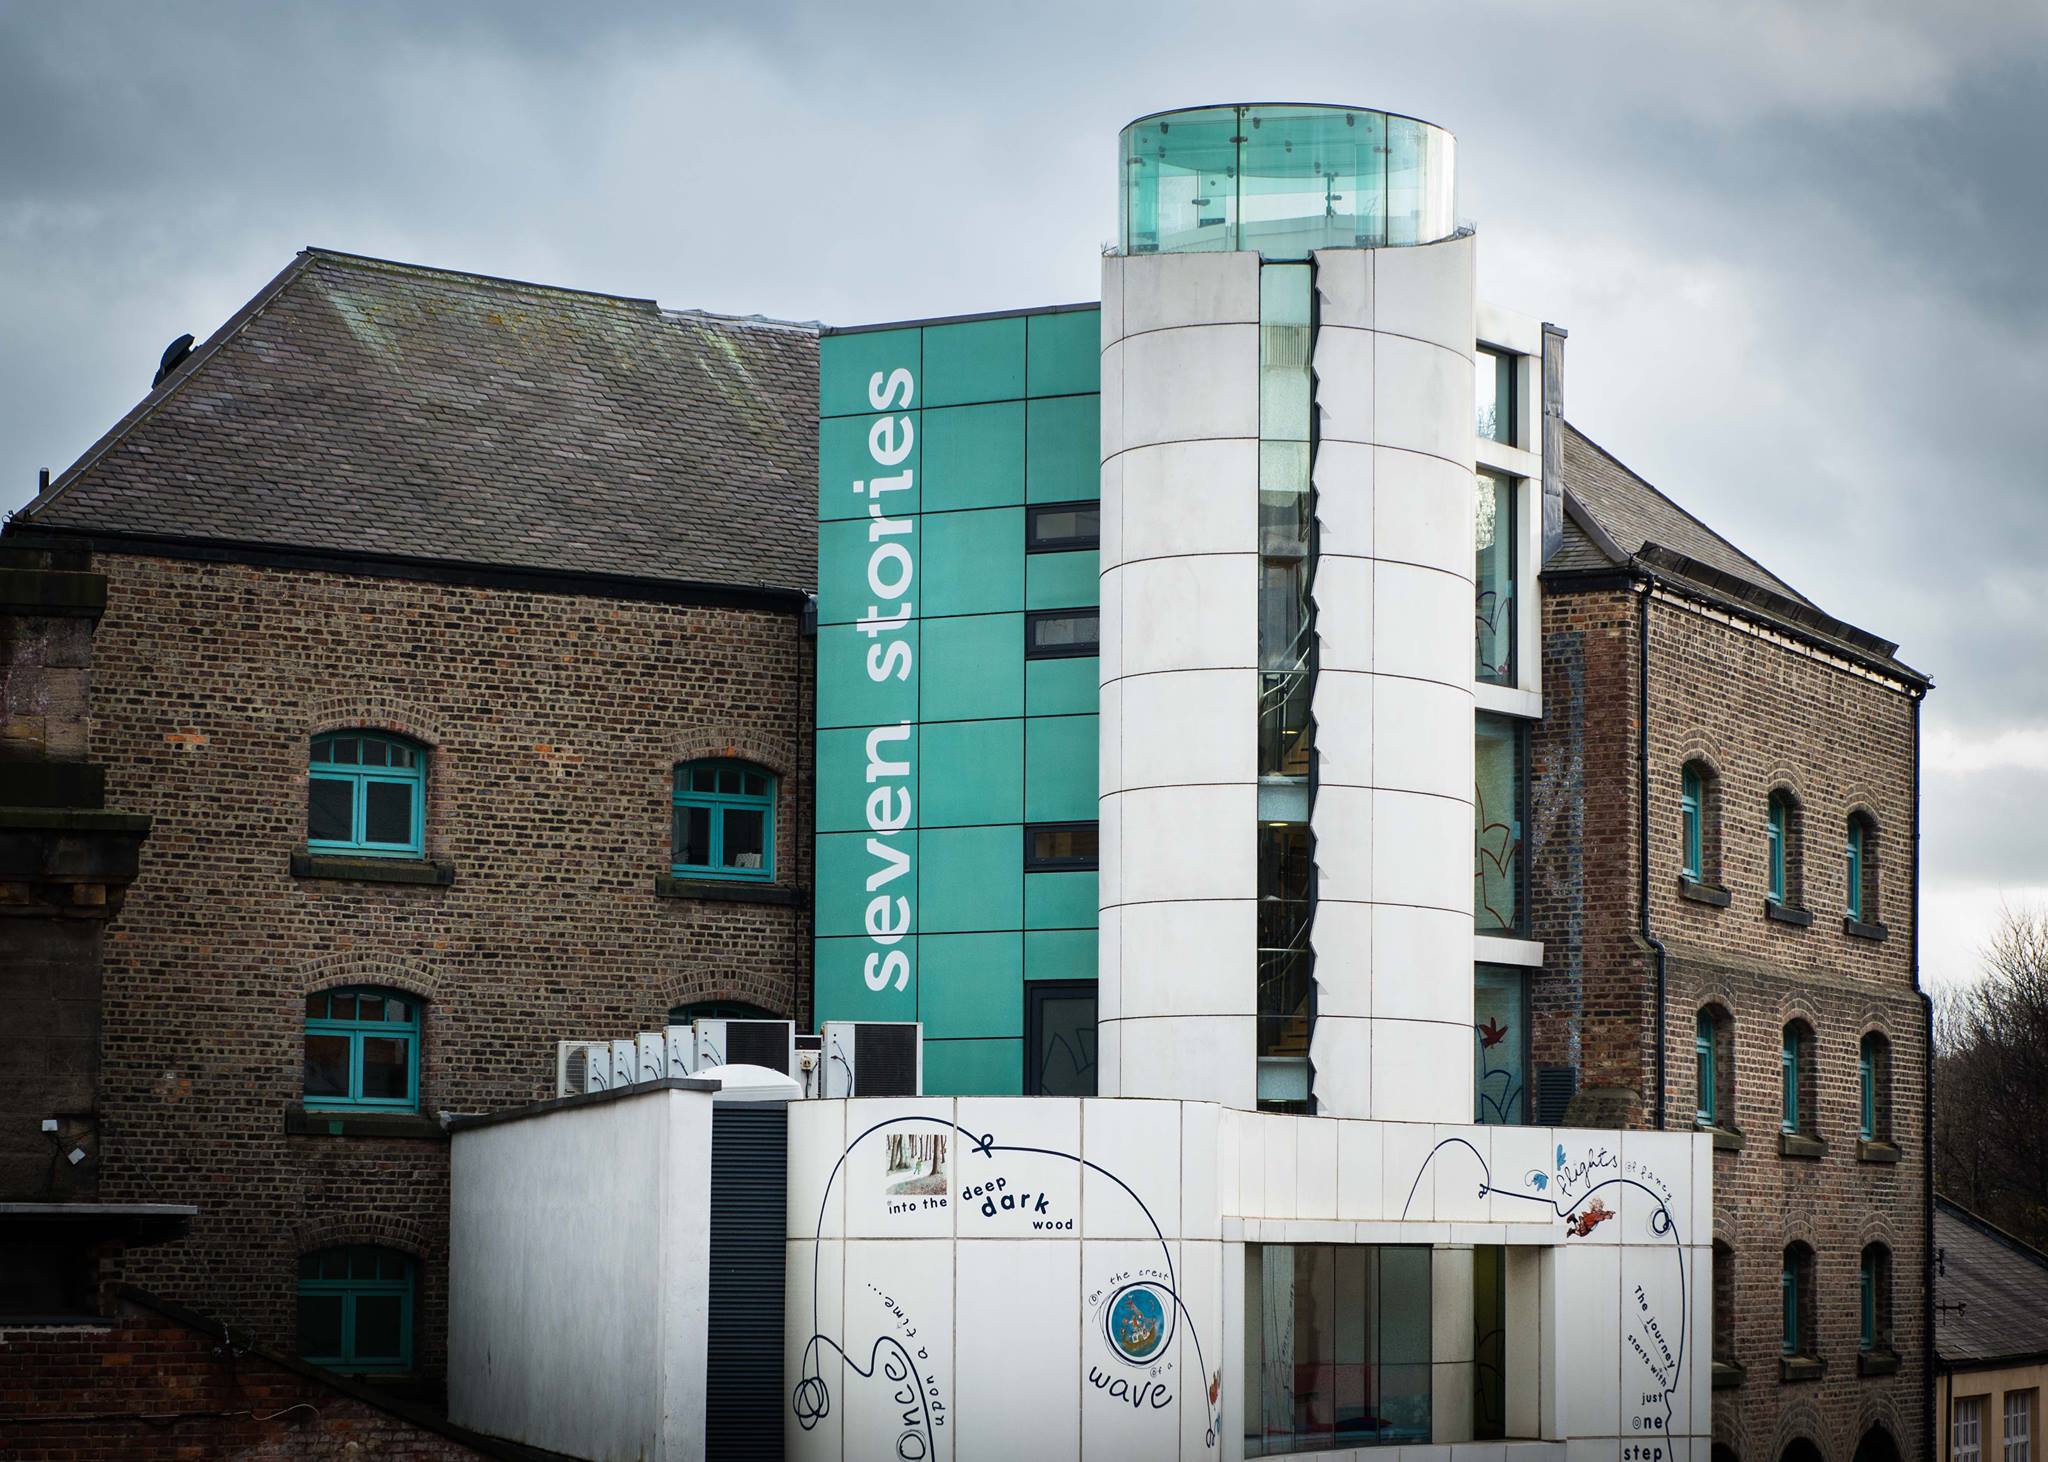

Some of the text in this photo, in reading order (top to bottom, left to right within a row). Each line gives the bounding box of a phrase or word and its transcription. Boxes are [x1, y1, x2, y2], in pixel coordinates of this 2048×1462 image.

[853, 367, 914, 992] seven stories
[1557, 1147, 1618, 1197] flights
[1641, 1165, 1673, 1204] fancy
[962, 1176, 1007, 1201] deep
[888, 1197, 947, 1214] into the
[981, 1192, 1050, 1218] dark
[1032, 1218, 1073, 1230] wood
[1110, 1271, 1131, 1285] the
[1139, 1268, 1169, 1281] crest
[1634, 1285, 1676, 1370] The journey
[918, 1346, 928, 1360] a
[1627, 1334, 1667, 1388] starts with
[1167, 1362, 1173, 1370] a
[1089, 1366, 1173, 1409] wave
[1641, 1391, 1663, 1406] just
[926, 1375, 946, 1426] upon
[1632, 1416, 1663, 1430] one
[1624, 1444, 1663, 1462] step
